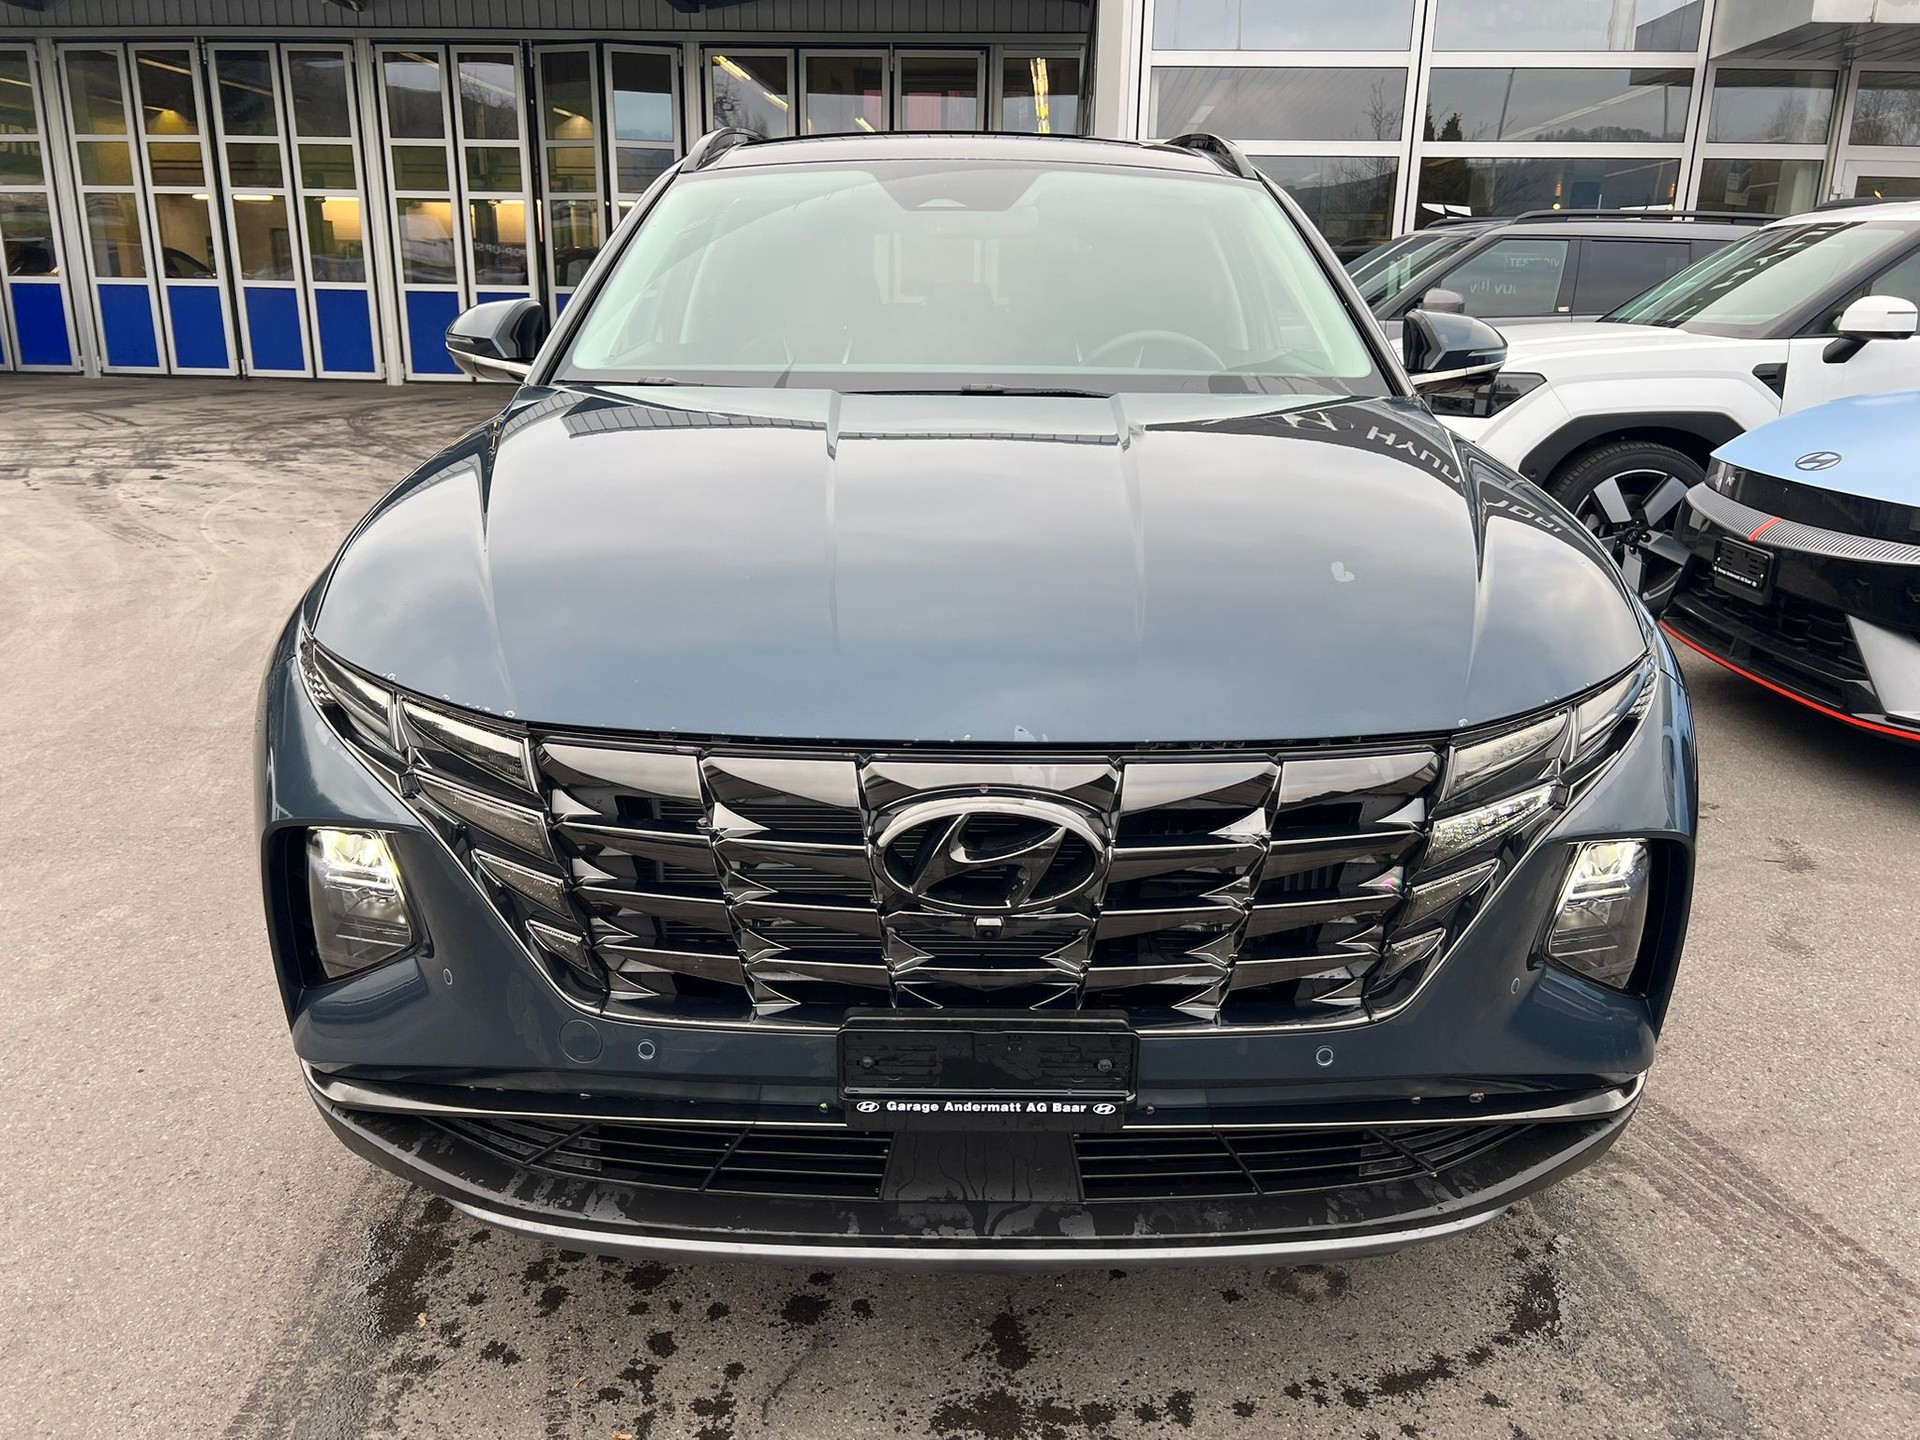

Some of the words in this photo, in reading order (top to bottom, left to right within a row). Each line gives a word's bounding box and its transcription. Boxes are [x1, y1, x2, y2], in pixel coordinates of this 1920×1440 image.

[886, 1100, 939, 1113] Garage
[944, 1101, 1021, 1112] Andermatt
[1026, 1102, 1047, 1112] AG
[1052, 1102, 1087, 1112] Baar
